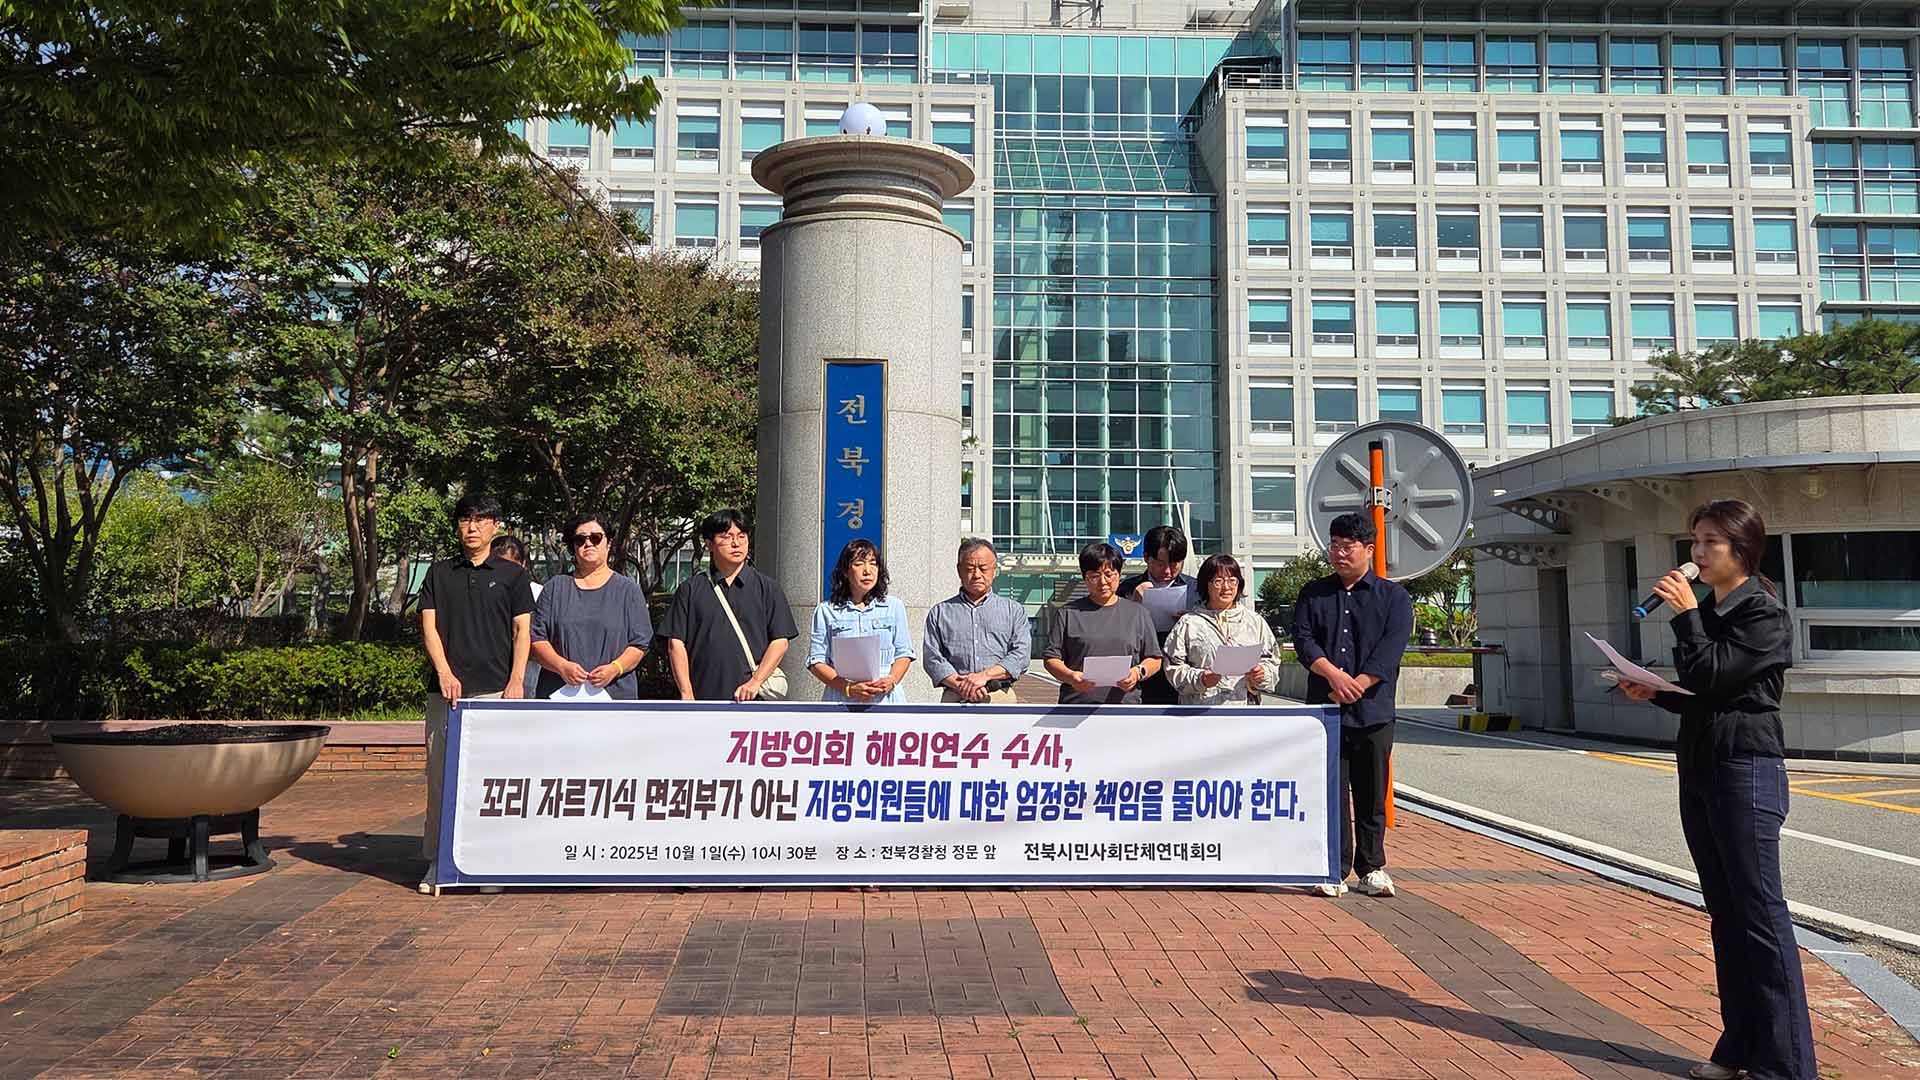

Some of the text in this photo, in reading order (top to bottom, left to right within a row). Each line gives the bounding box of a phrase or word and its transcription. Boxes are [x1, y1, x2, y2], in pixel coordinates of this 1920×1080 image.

[726, 729, 1073, 772] 지방의회 해외연수 수사,
[479, 777, 1305, 823] 꼬리 자르기식 면죄부가 아닌 지방의원들에 대한 엄정한 책임을 물어야 한다.
[609, 845, 658, 861] 2025년
[665, 845, 695, 861] 10월
[701, 845, 746, 862] 1일(수)
[752, 845, 781, 861] 10시
[786, 845, 817, 861] 30분
[880, 844, 947, 861] 전북경찰청
[951, 844, 979, 861] 정문
[983, 844, 997, 861] 앞
[1023, 842, 1222, 862] 전북시민사회단체연대회의
